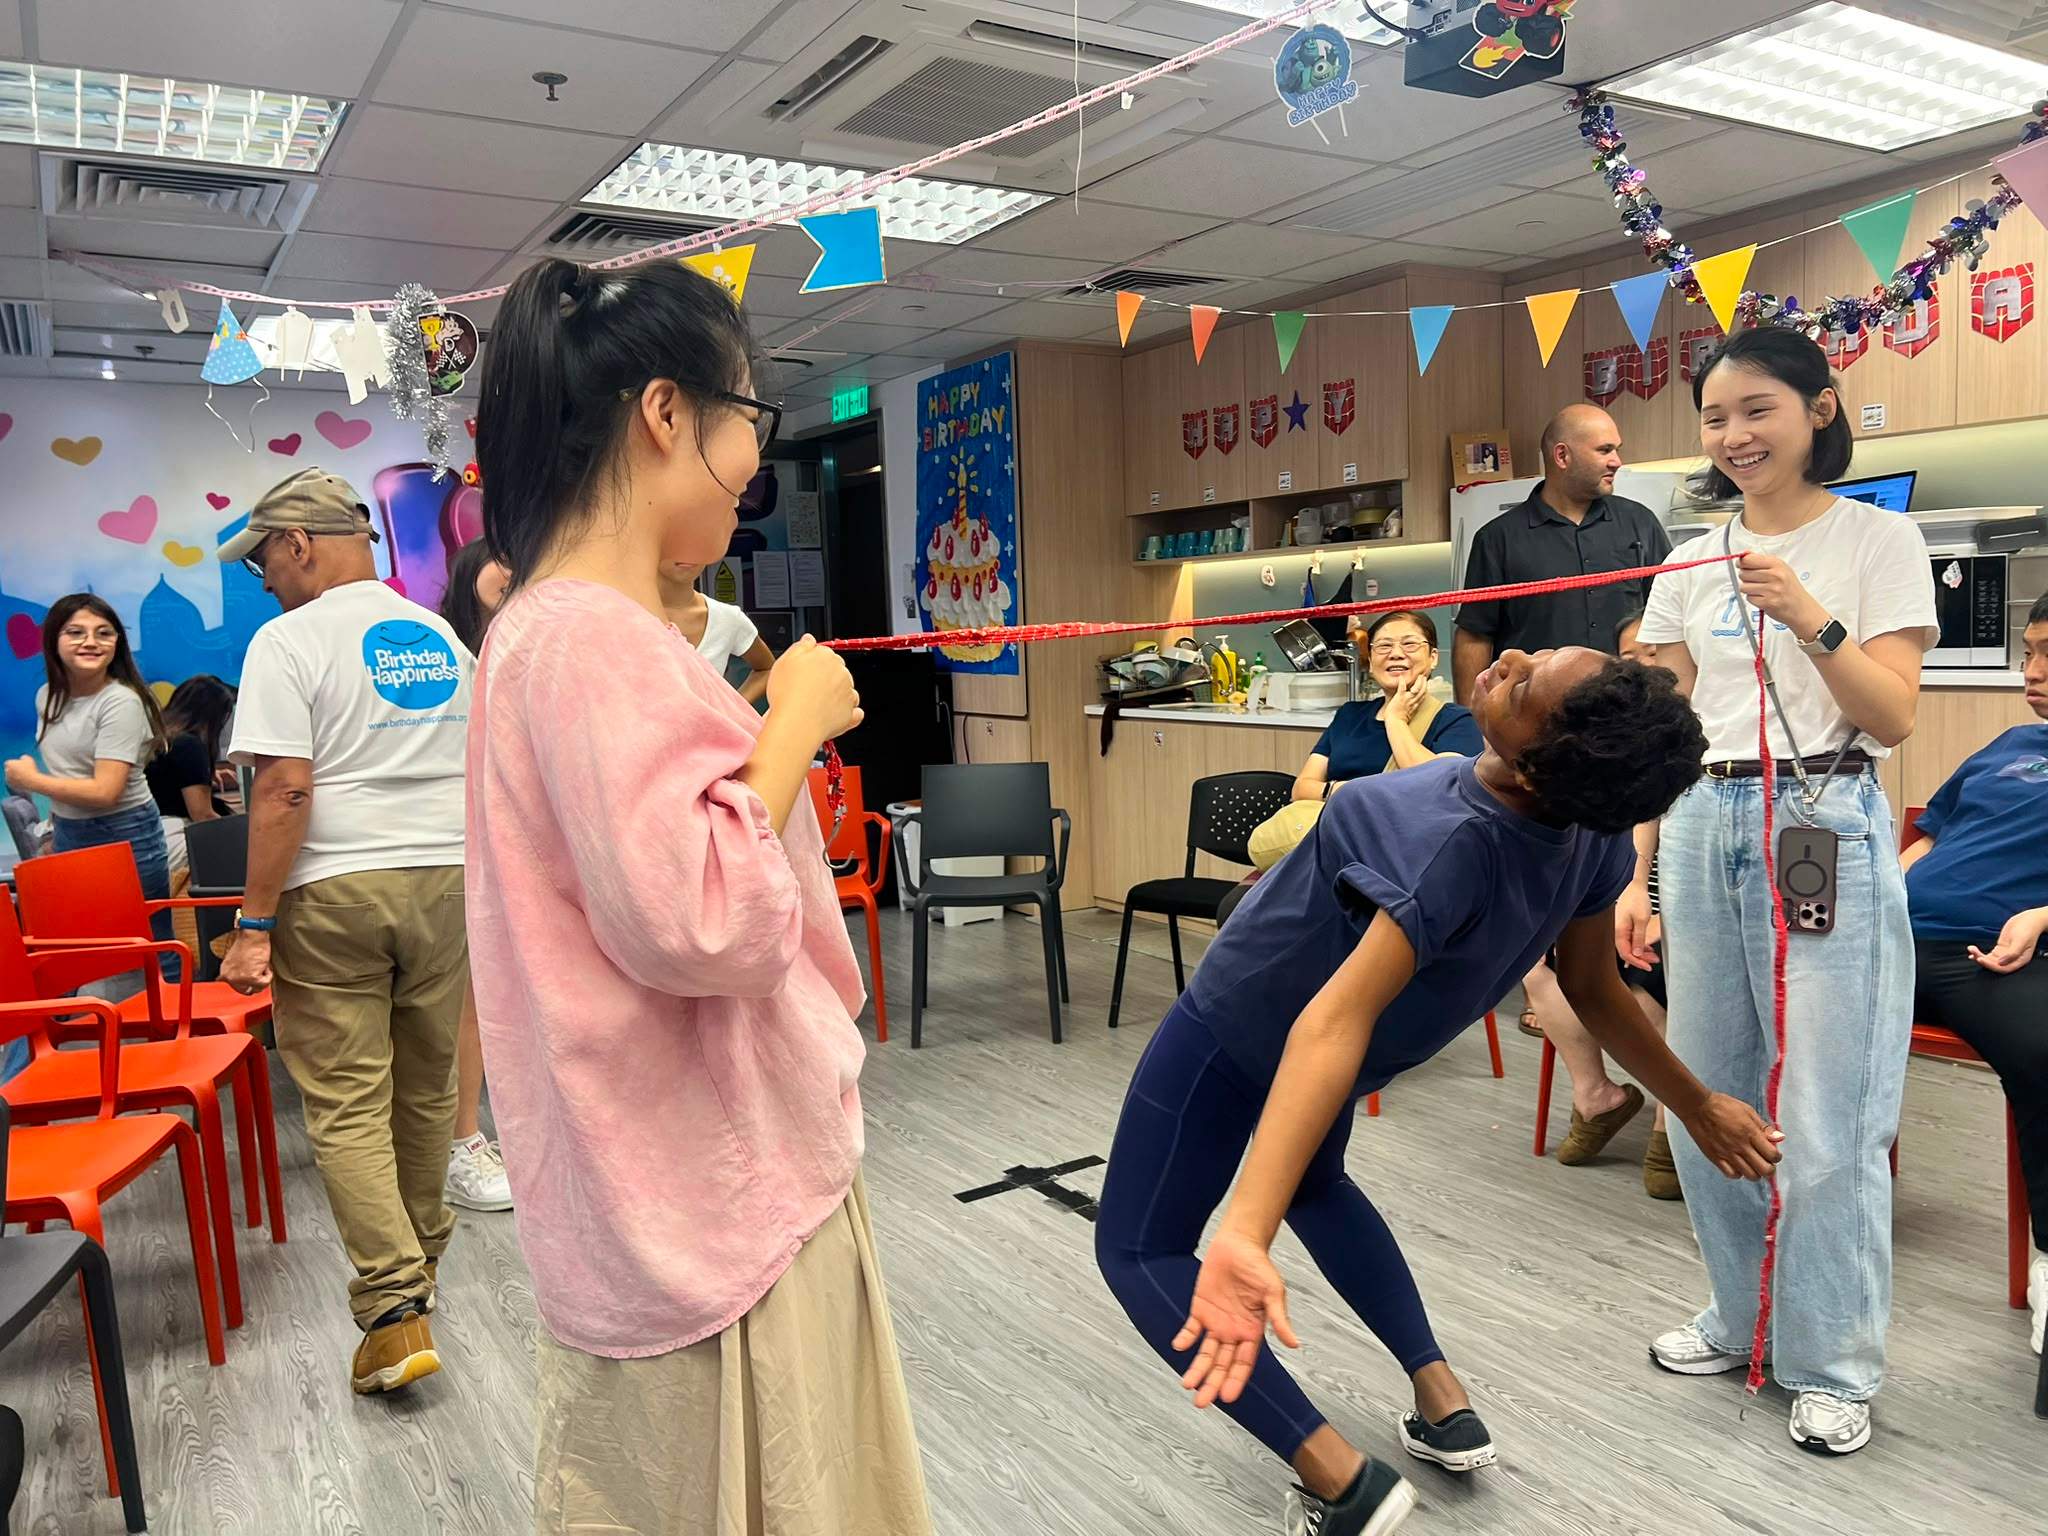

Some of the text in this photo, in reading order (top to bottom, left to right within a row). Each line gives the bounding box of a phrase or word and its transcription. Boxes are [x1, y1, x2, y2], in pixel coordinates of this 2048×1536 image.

[1289, 82, 1357, 125] BIRTHDAY
[1297, 77, 1344, 108] HAPPY
[928, 381, 980, 421] HAPPY
[923, 404, 1006, 452] BIRTHDAY
[374, 648, 447, 669] Birthday
[366, 664, 462, 689] Happiness
